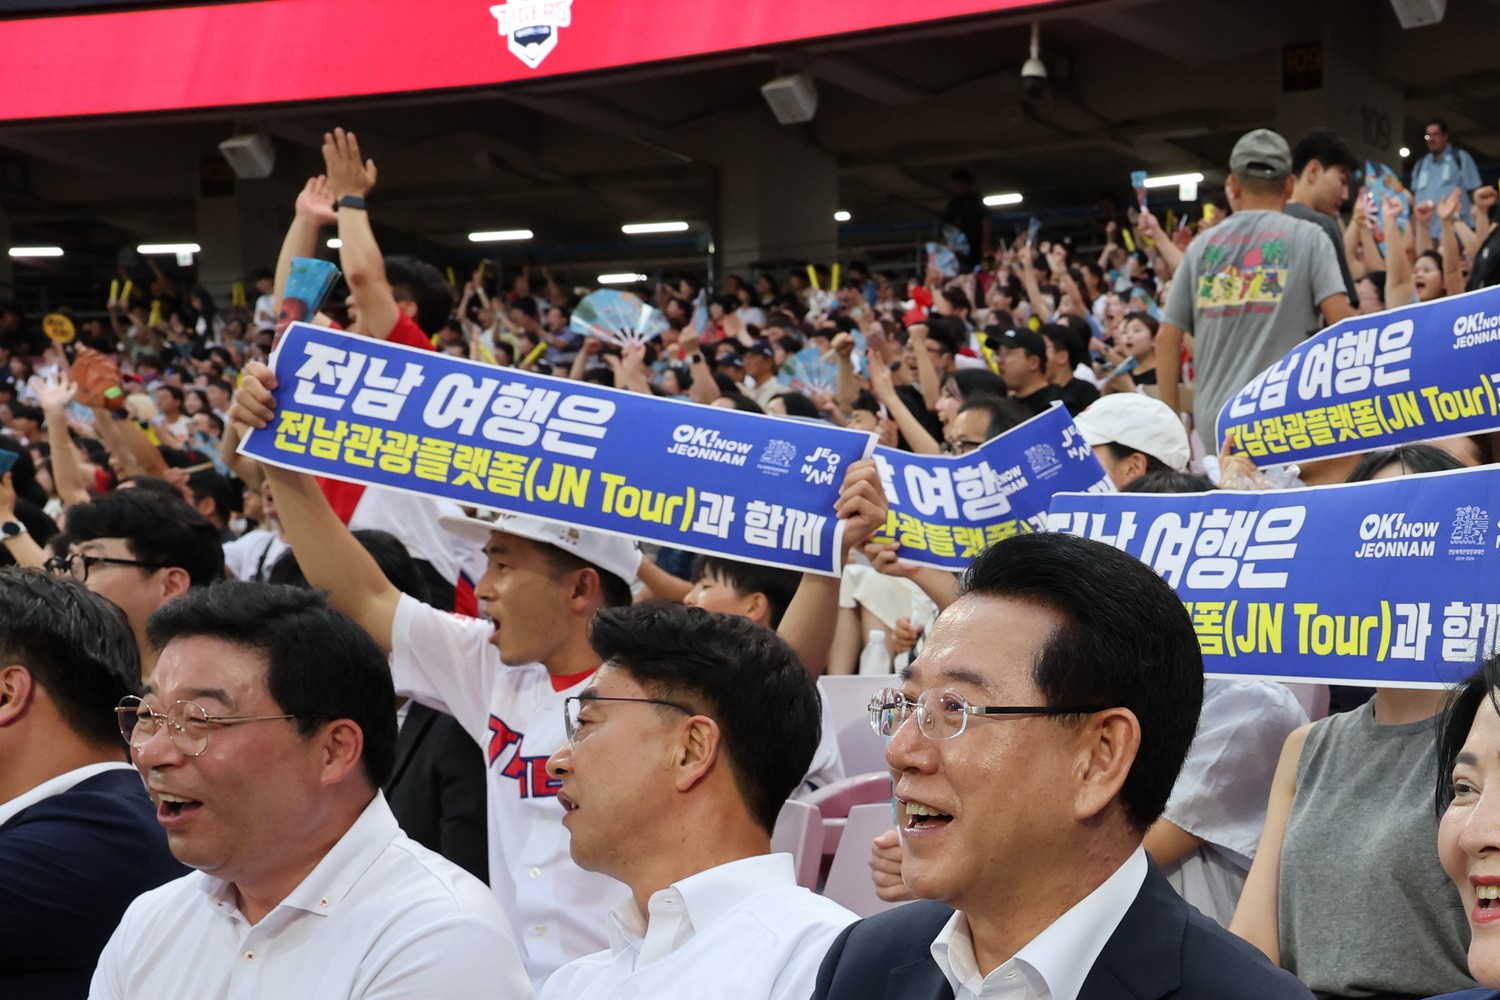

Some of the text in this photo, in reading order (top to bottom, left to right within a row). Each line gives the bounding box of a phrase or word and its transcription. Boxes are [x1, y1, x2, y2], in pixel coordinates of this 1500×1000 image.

[293, 341, 616, 460] 전남 여행은
[1298, 319, 1414, 401] 여행은
[273, 410, 828, 556] 전남관광플랫폼(JN Tour)과 함께
[667, 443, 747, 467] JEONNAM
[1141, 505, 1306, 590] 여행은
[1355, 541, 1435, 559] JEONNAM
[1185, 601, 1285, 658] 폼(JN
[1293, 600, 1432, 662] Tour)과
